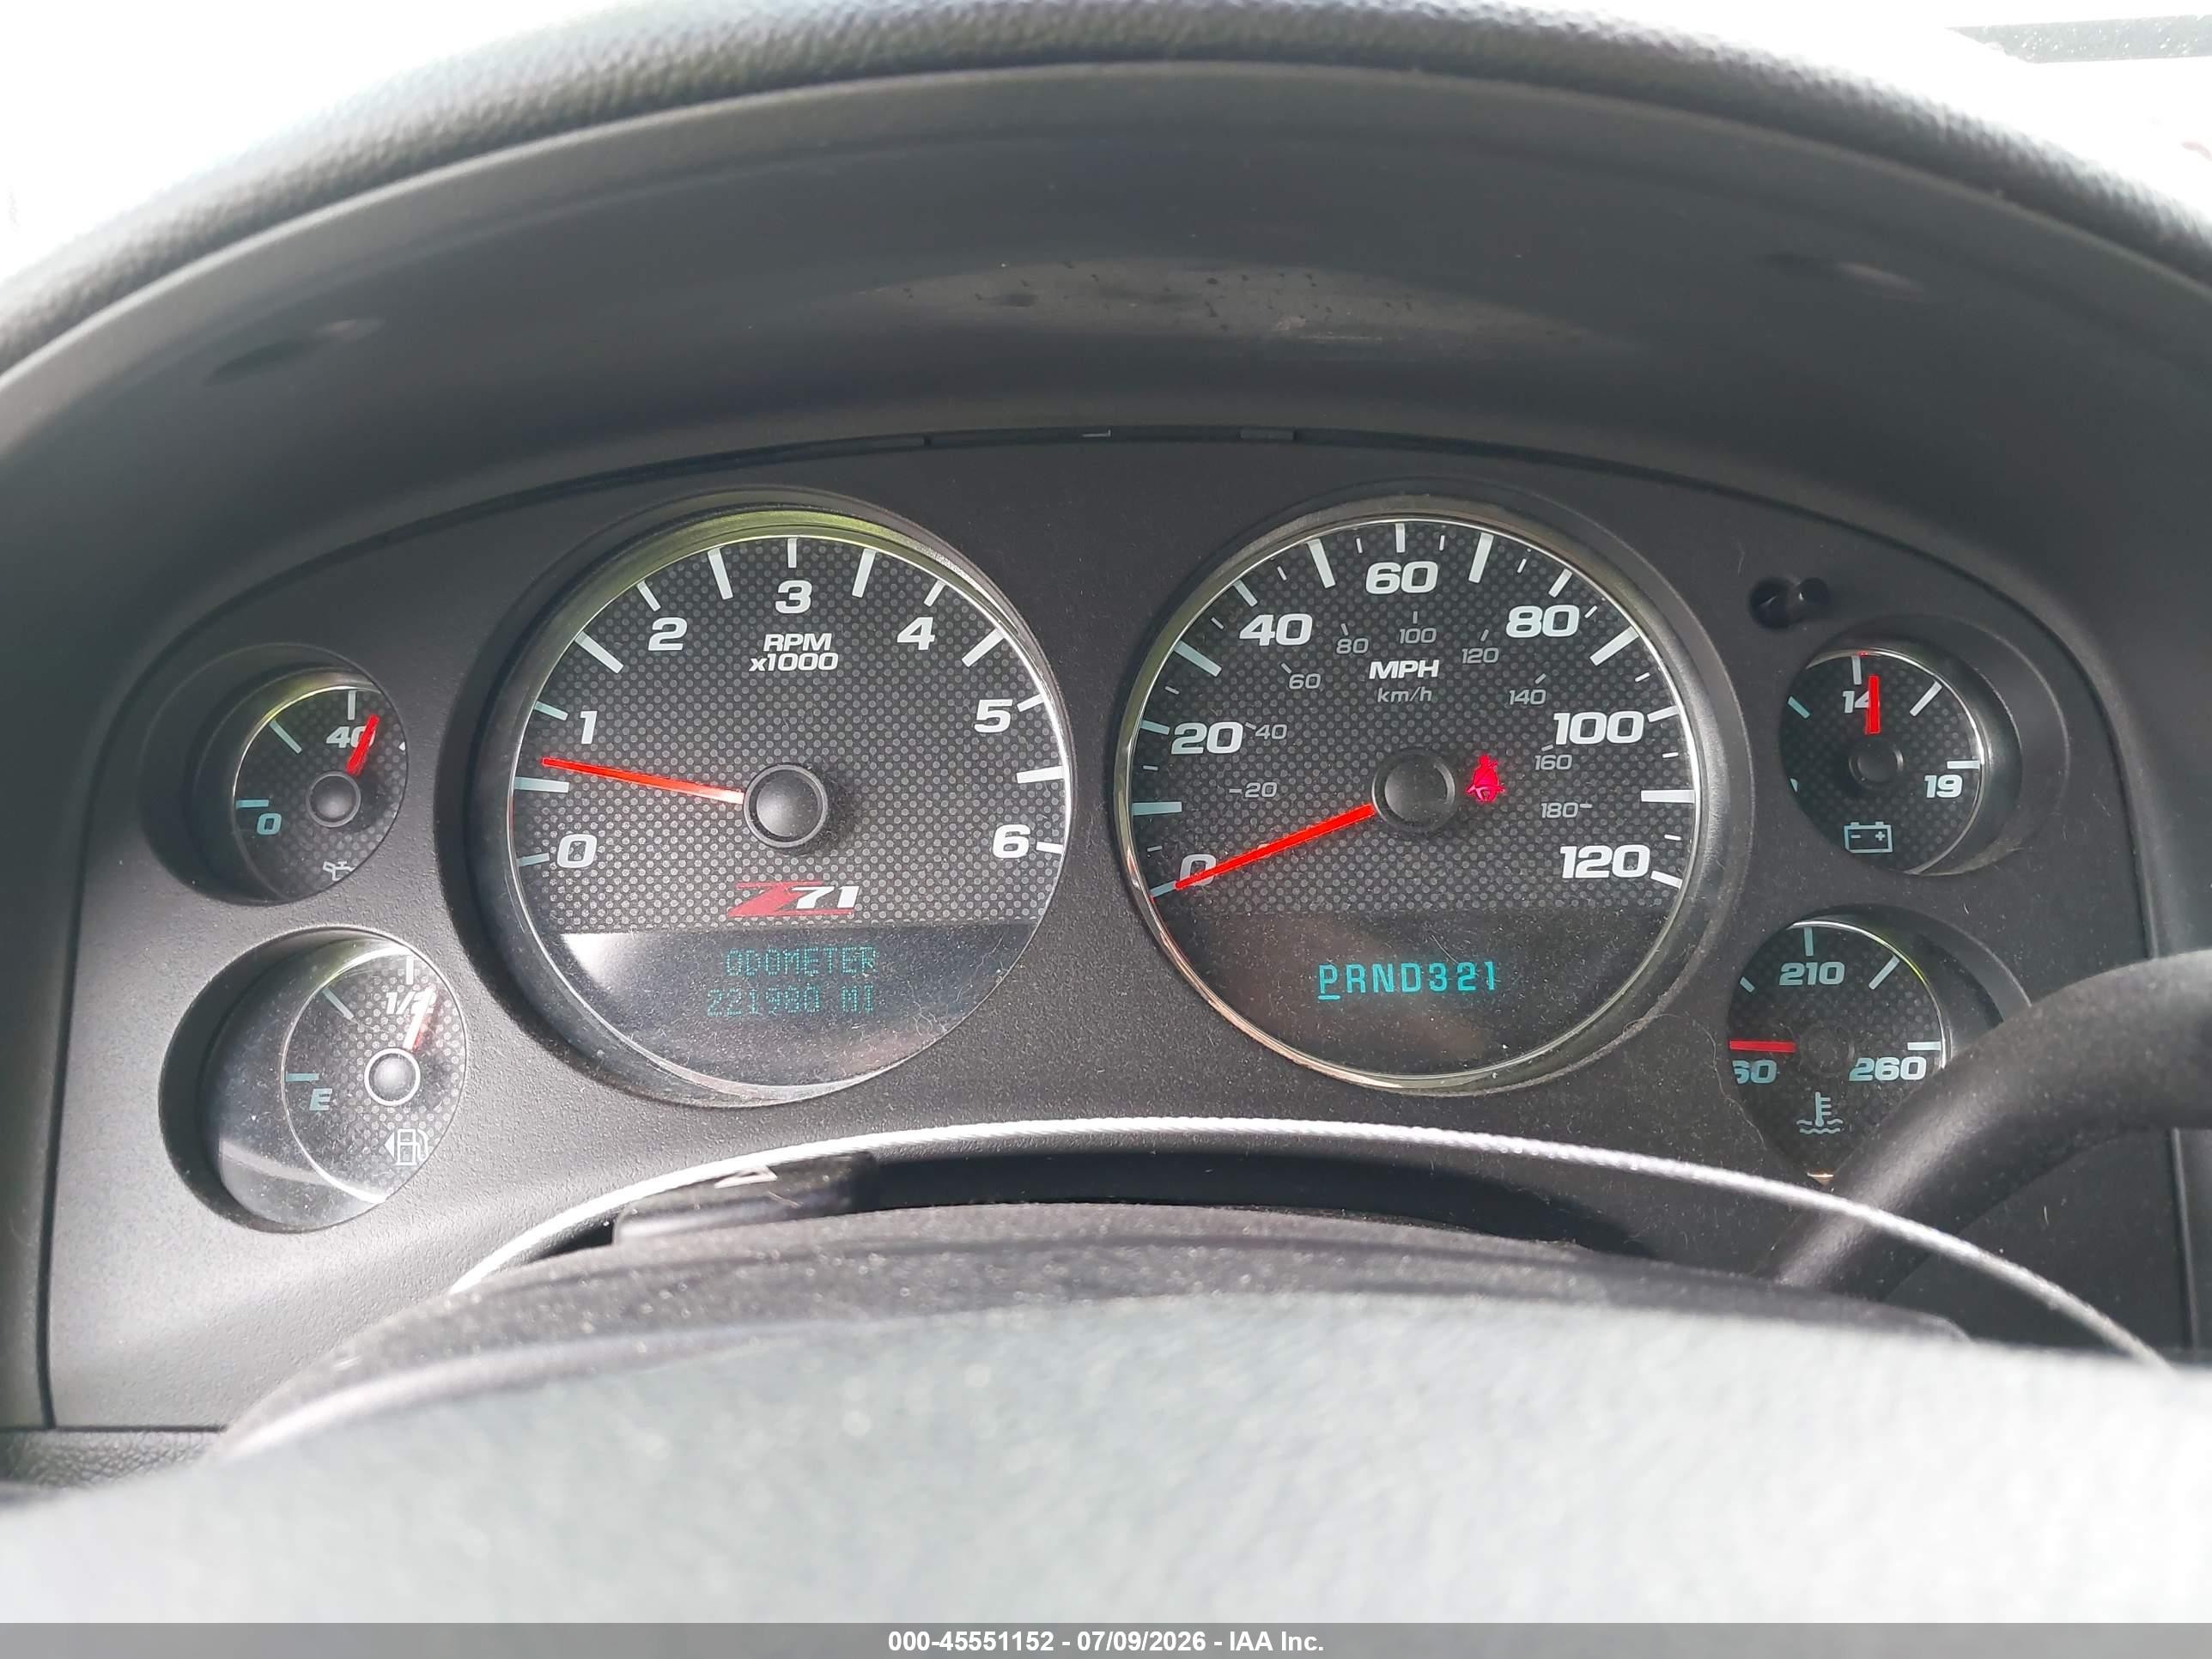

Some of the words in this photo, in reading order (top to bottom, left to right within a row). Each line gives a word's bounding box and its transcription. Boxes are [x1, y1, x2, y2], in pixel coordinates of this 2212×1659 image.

[1365, 562, 1437, 594] 60
[775, 580, 812, 613] 3
[897, 617, 934, 650] 4
[1239, 615, 1312, 646] 40
[1506, 605, 1579, 637] 80
[647, 617, 688, 651] 2
[763, 635, 831, 650] RPM
[1336, 638, 1369, 654] 80
[1398, 629, 1437, 644] 100
[750, 653, 837, 671] x1000
[1462, 649, 1499, 664] 120
[1369, 661, 1439, 678] MPH
[1289, 675, 1321, 690] 60
[1376, 689, 1432, 702] km/h
[1509, 690, 1547, 706] 140
[579, 710, 599, 744] 1
[973, 700, 1012, 732] 5
[1553, 712, 1644, 744] 100
[326, 726, 376, 748] 40
[1170, 721, 1243, 755] 20
[1255, 723, 1287, 740] 40
[1534, 754, 1572, 771] 160
[1243, 782, 1278, 799] 20
[1924, 775, 1963, 799] 19
[1540, 802, 1578, 819] 180
[256, 812, 282, 836] 0
[556, 833, 599, 869] 0
[992, 824, 1030, 859] 6
[1180, 854, 1217, 886] 0
[1559, 845, 1651, 878] 120
[728, 880, 860, 917] Z71
[726, 946, 878, 976] ODOMETER
[1779, 961, 1845, 986] 210
[841, 984, 874, 1014] MI
[1848, 1056, 1927, 1081] 260
[309, 1086, 332, 1110] E
